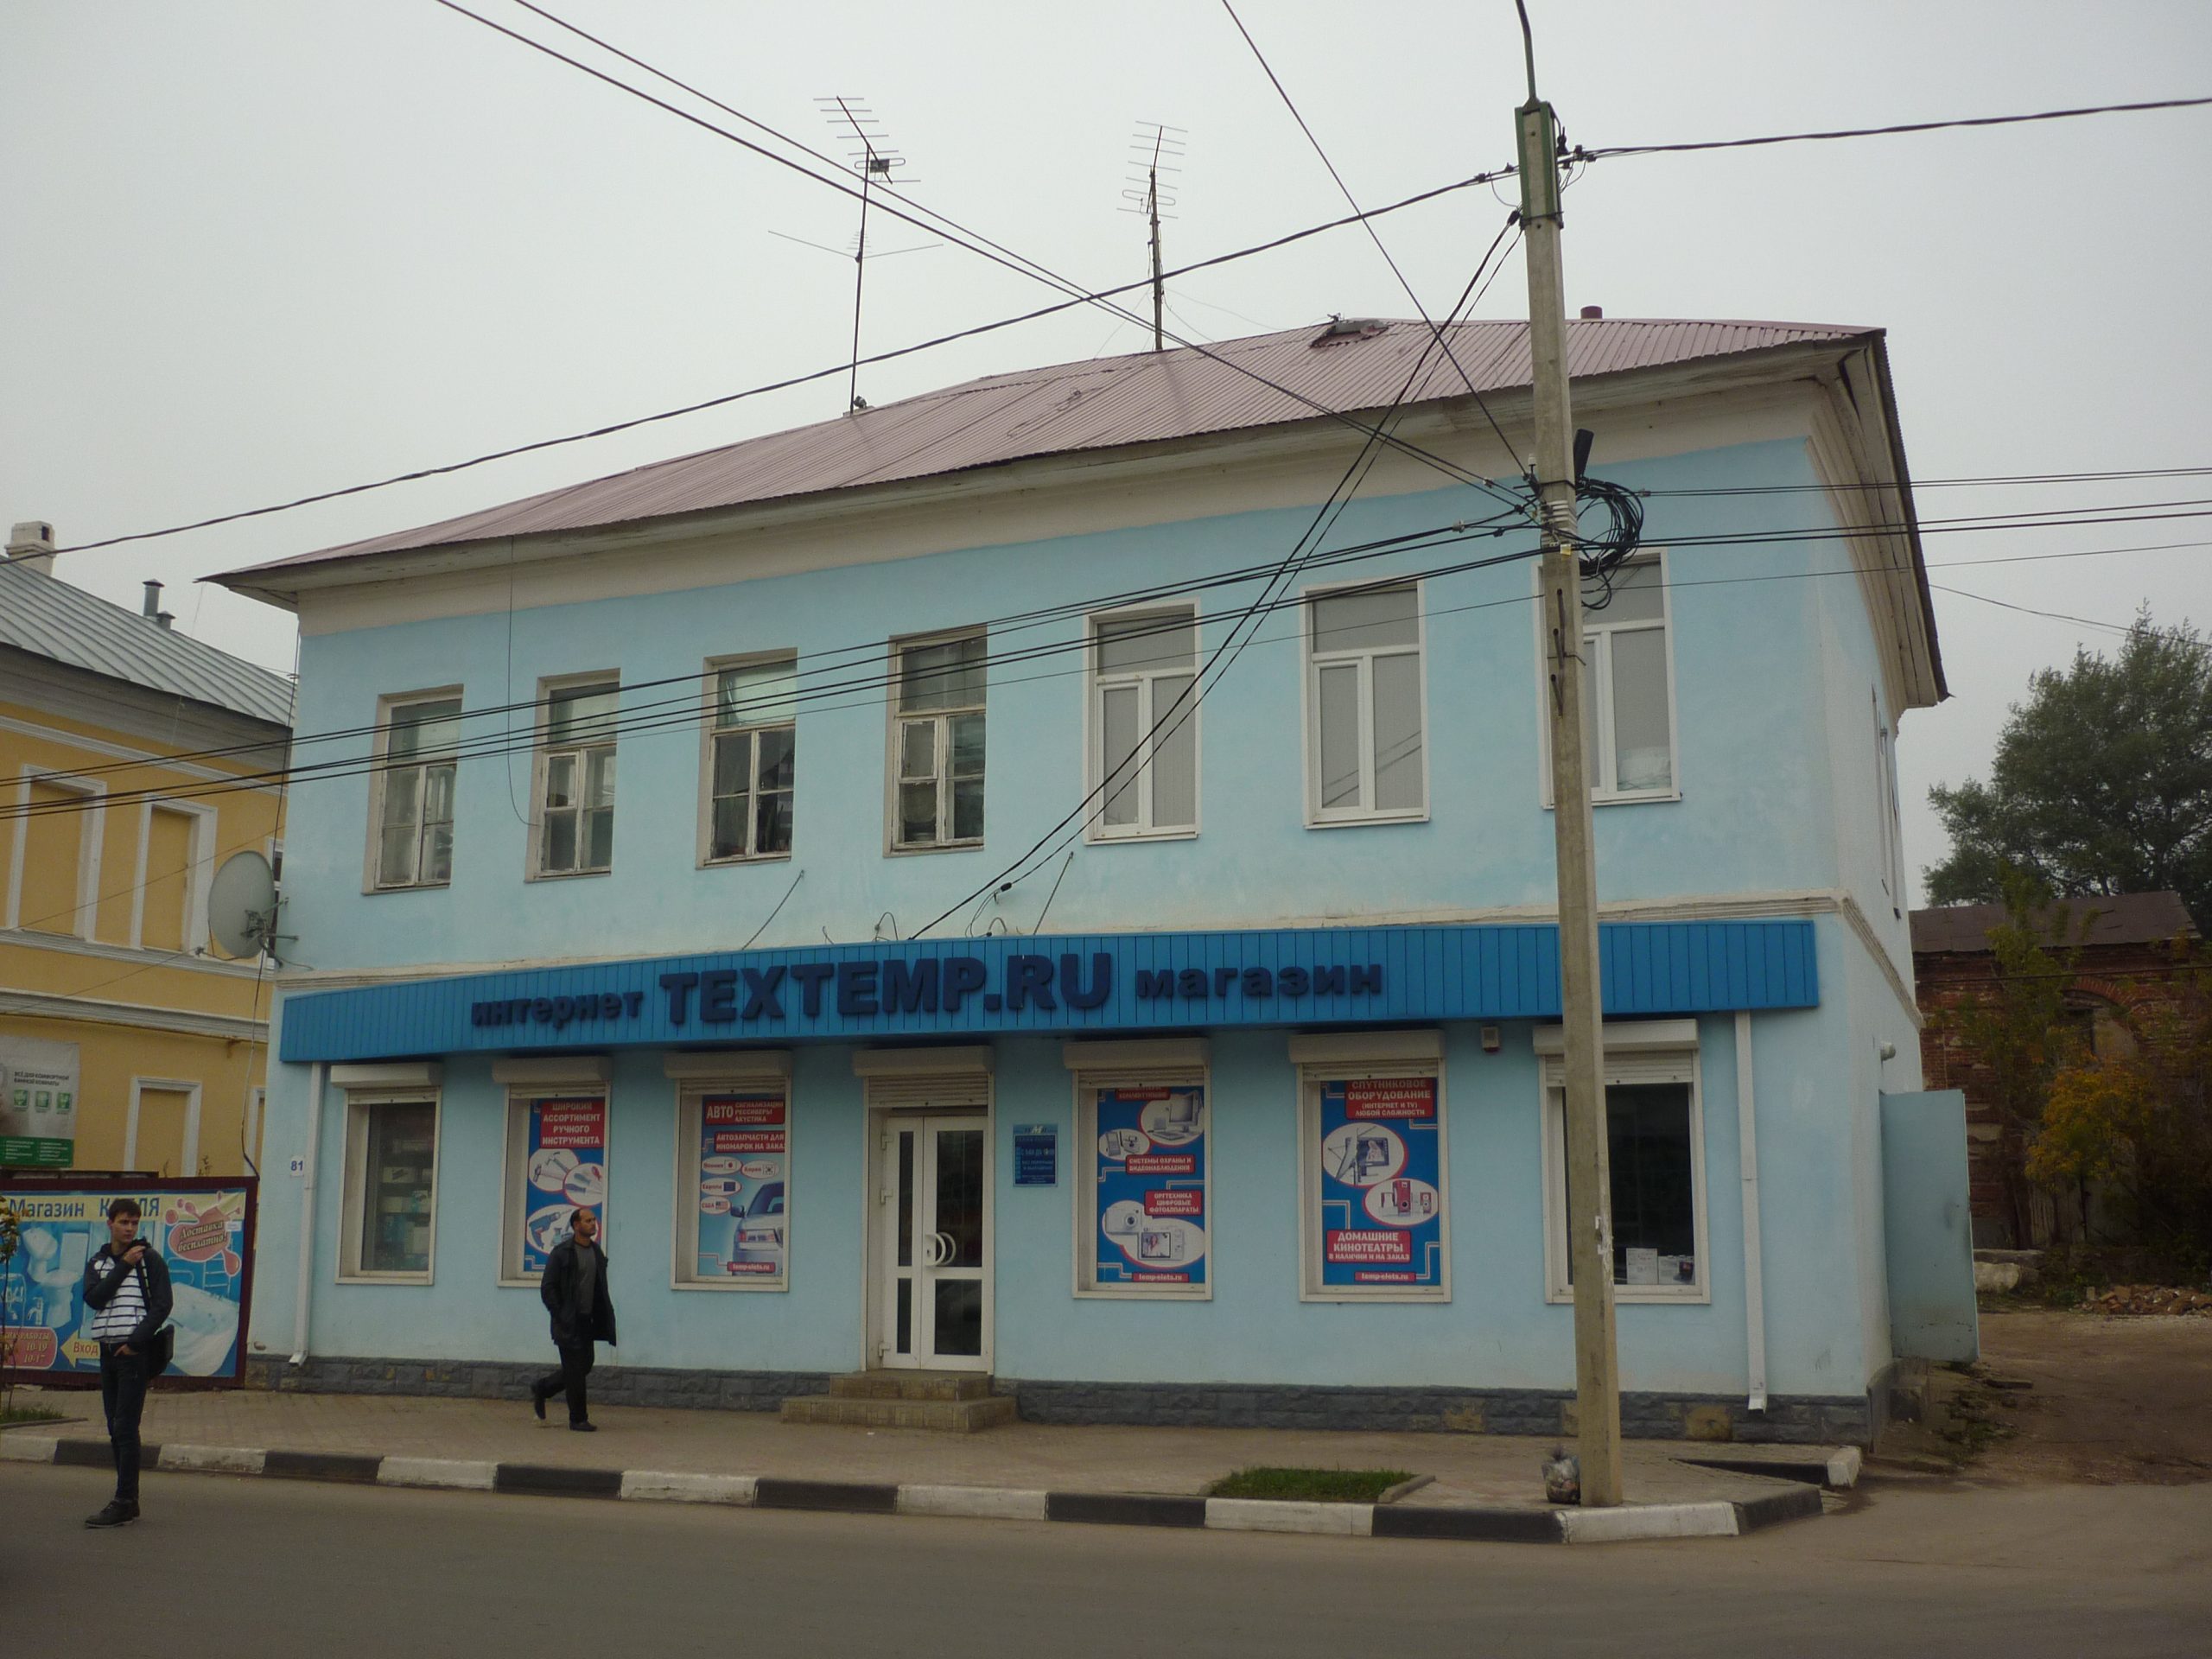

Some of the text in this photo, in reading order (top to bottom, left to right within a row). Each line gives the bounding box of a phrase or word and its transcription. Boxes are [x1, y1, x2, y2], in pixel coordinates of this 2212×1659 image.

[471, 952, 1382, 1029] интернет TEXTEMP.RU магазин
[1352, 1079, 1427, 1089] СПУТНИКОВОЕ
[1348, 1090, 1431, 1100] ОБОРУДОВАНИЕ
[707, 1105, 734, 1119] АВТО
[543, 1114, 601, 1122] АССОРТИМЕНТ
[553, 1125, 590, 1134] РУЧНОГО
[542, 1136, 600, 1145] ИНСТРУМЕНТА
[291, 1160, 303, 1171] 81
[9, 1197, 160, 1217] Магазин КЛЯ
[180, 1221, 224, 1239] Доставка
[1338, 1232, 1398, 1242] ДОМАШНИЕ
[1333, 1243, 1403, 1252] КИНОТЕАТРЫ
[73, 1342, 99, 1356] Вход
